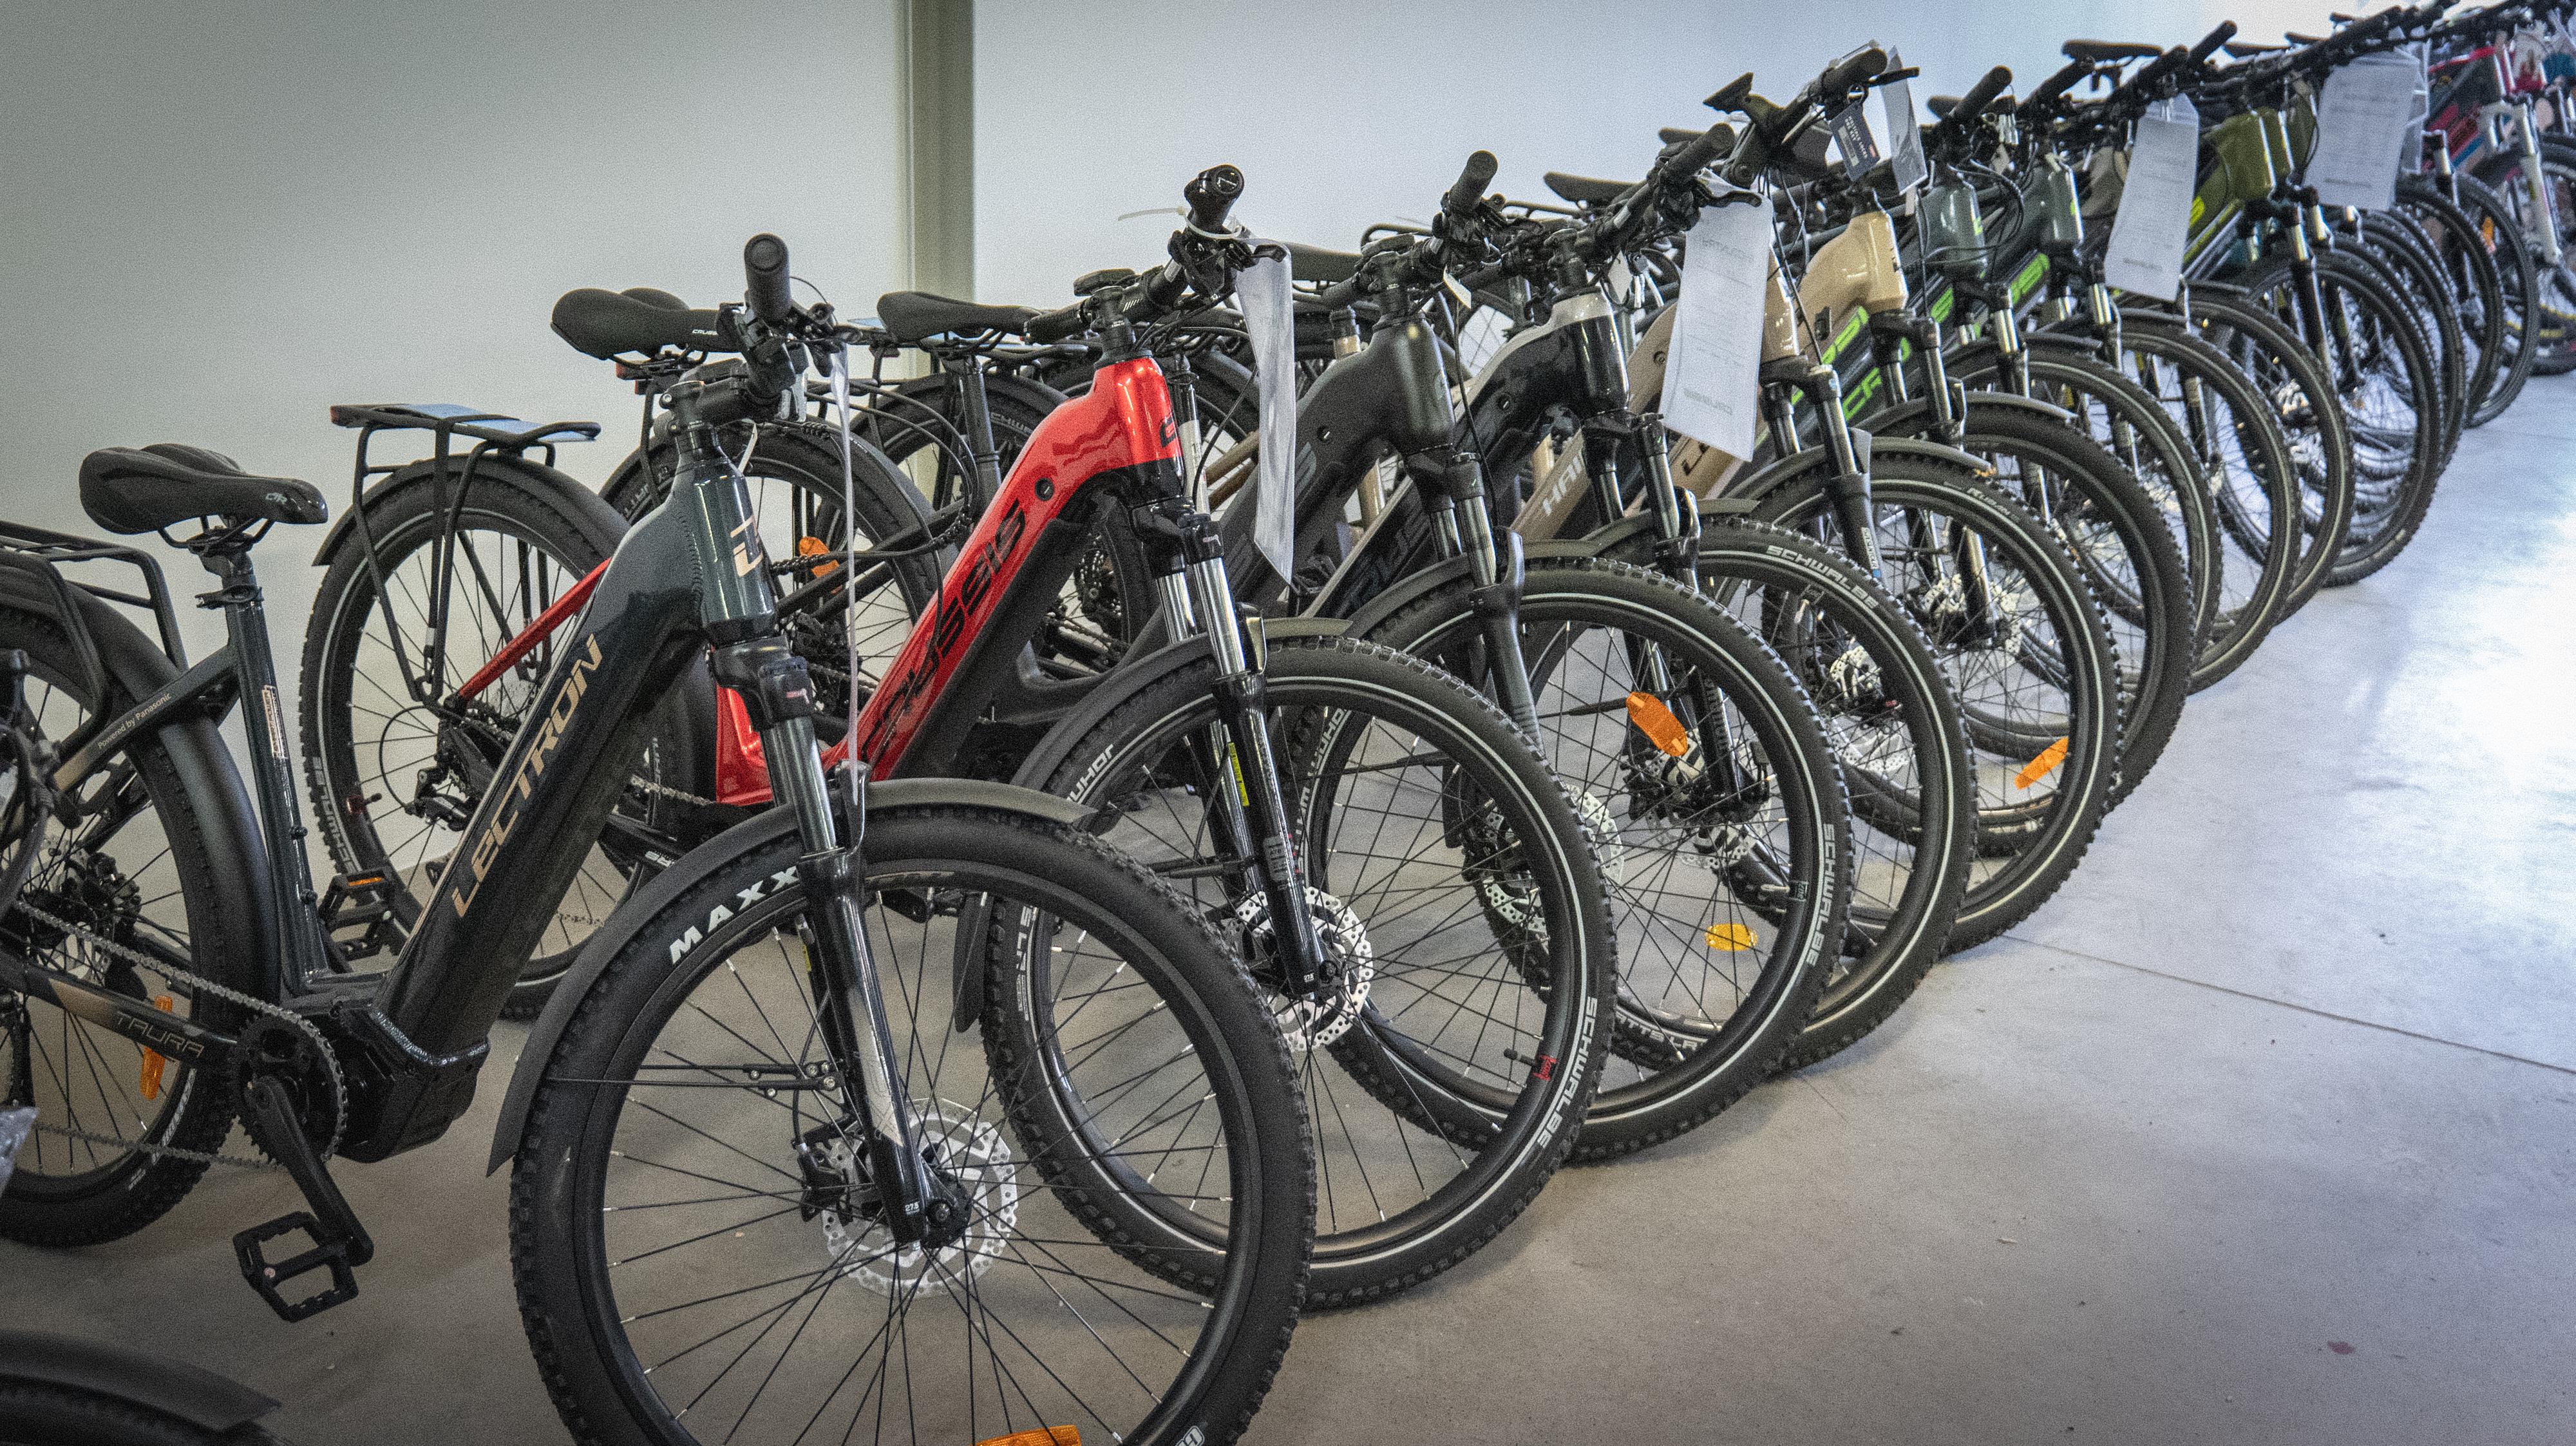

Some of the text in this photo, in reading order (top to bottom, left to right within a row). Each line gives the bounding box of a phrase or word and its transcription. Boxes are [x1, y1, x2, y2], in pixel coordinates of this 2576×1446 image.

[1766, 545, 1879, 609] SCHWALBE
[98, 693, 172, 749] Powered by Panasonic
[451, 633, 603, 918] LECTRON
[312, 756, 357, 874] SCHWALBE
[1806, 824, 1836, 966] SCHWALBE
[117, 1011, 205, 1058] TAURA
[1537, 996, 1598, 1149] SCHWALBE
